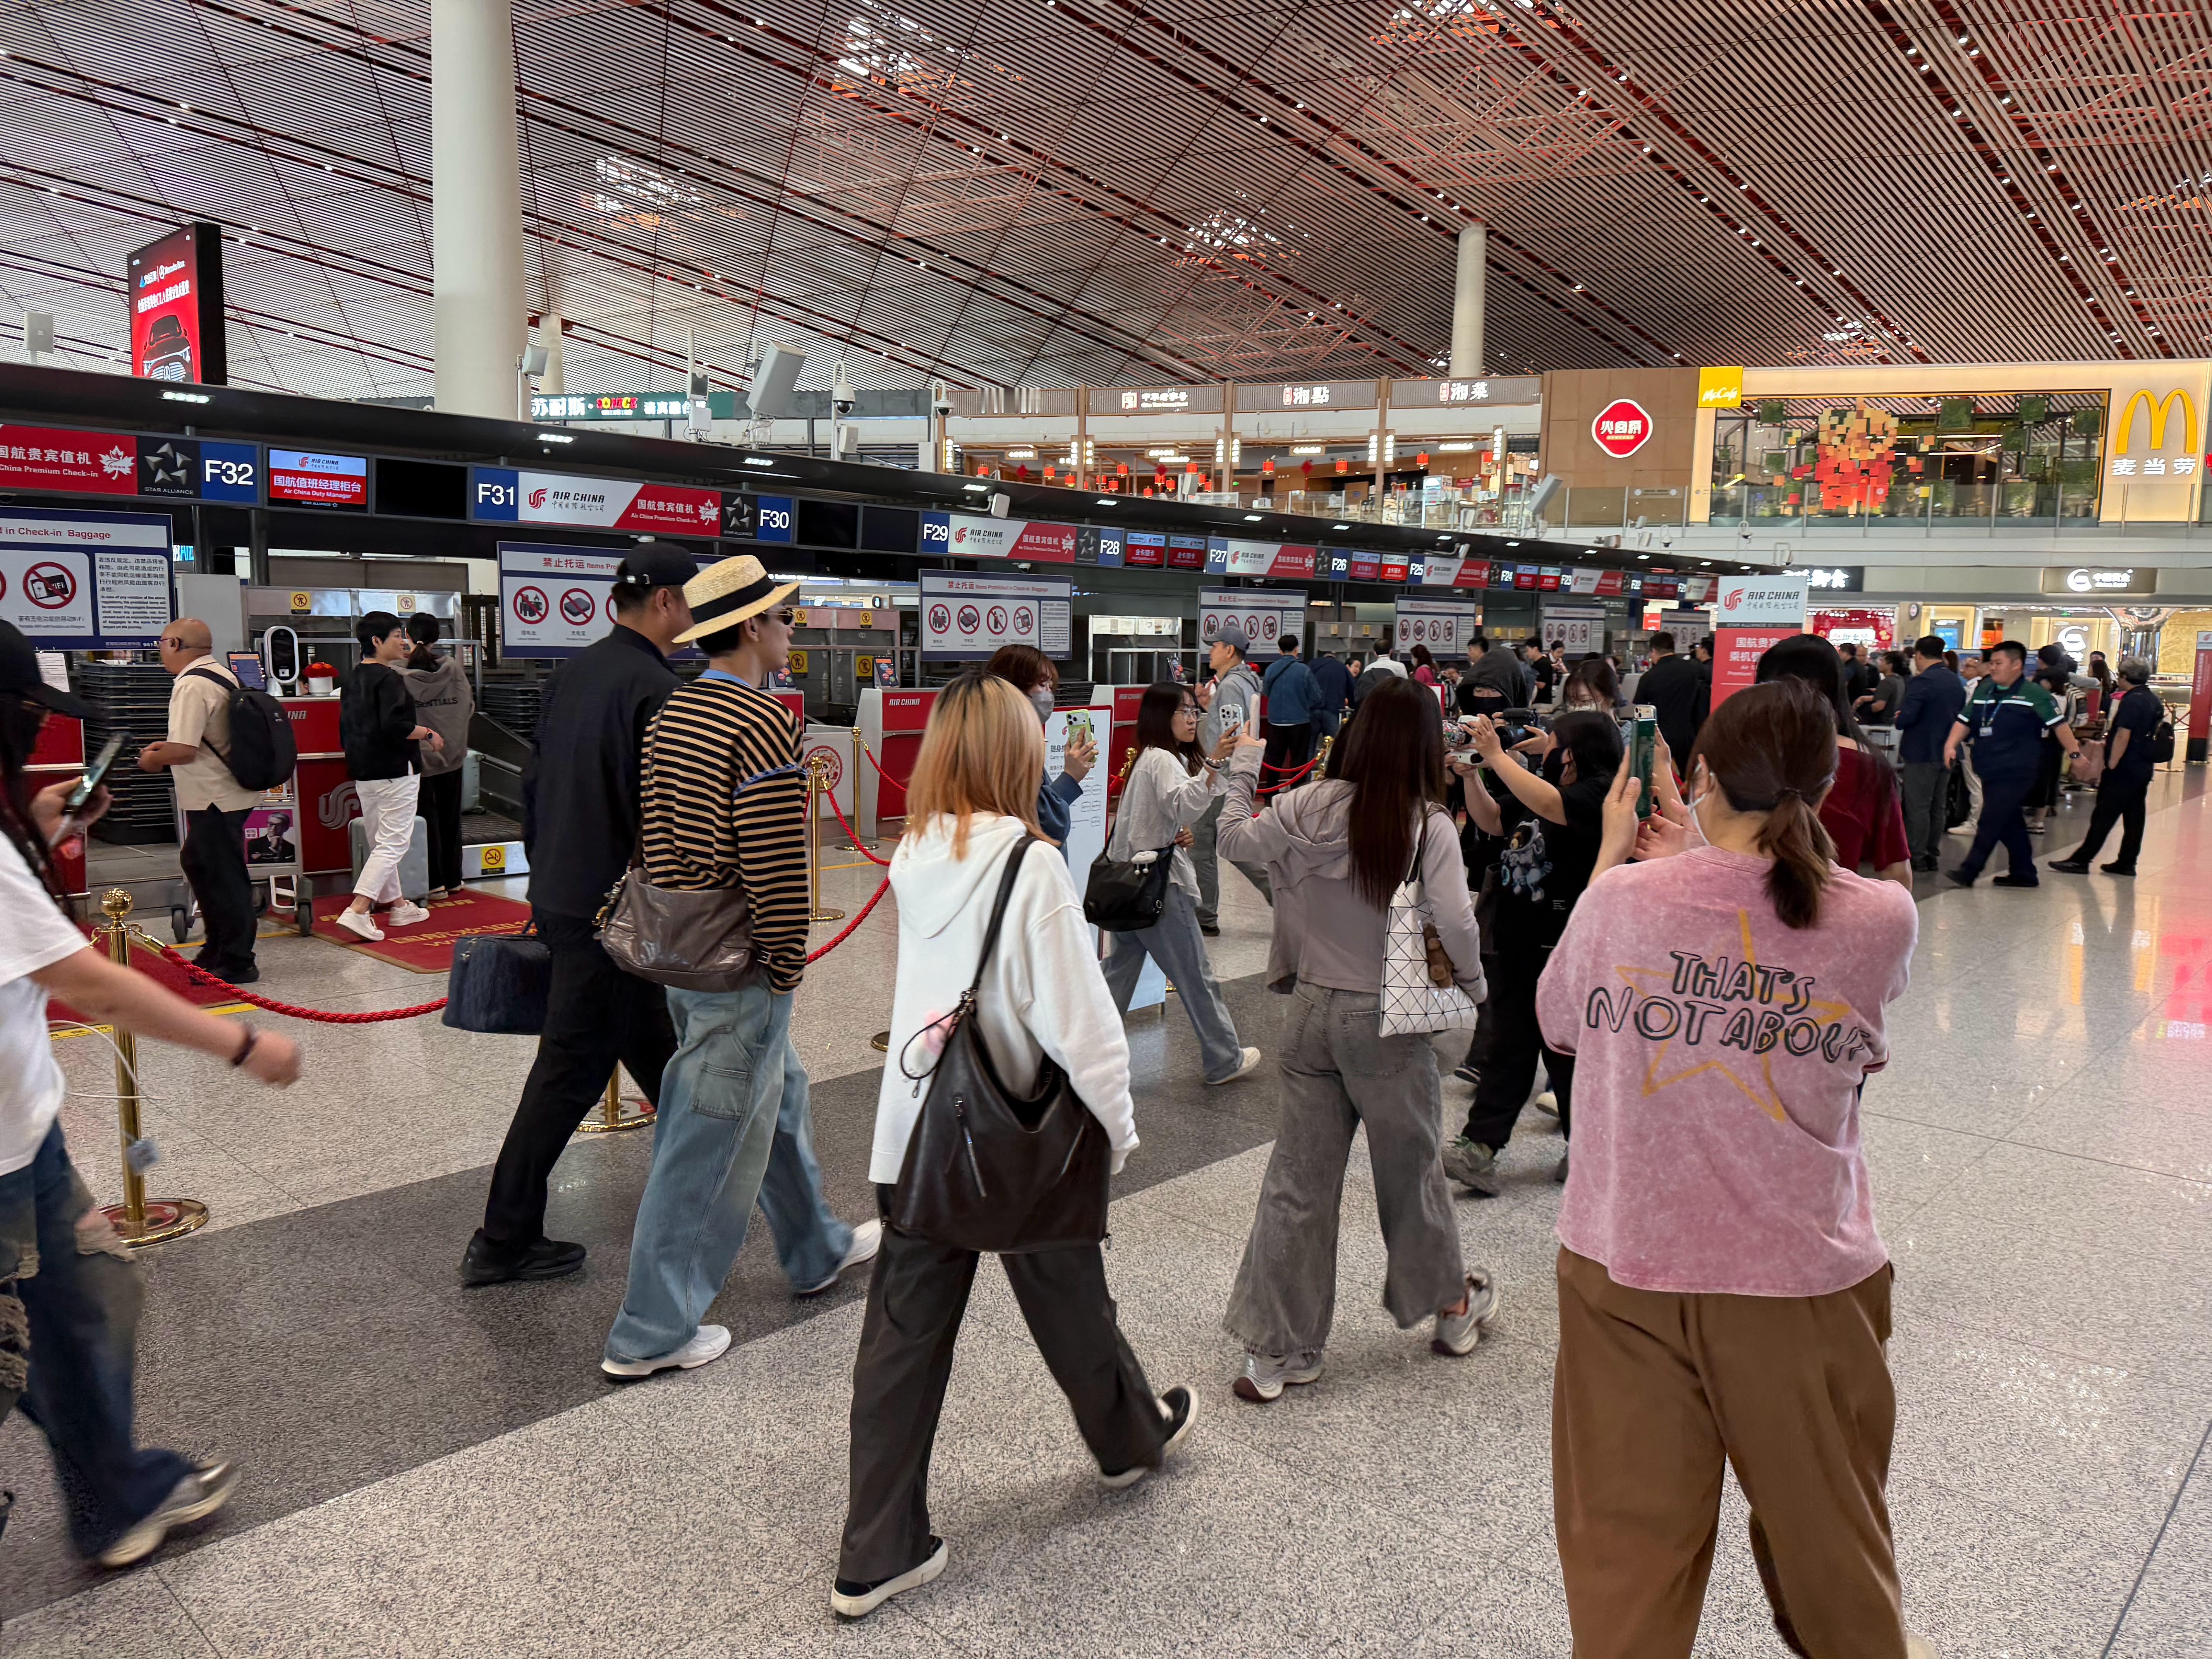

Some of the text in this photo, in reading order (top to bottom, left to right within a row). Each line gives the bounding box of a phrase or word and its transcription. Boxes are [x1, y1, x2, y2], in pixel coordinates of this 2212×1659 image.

[1450, 381, 1489, 400] 湘菜
[0, 445, 92, 465] 国航贵宾值机
[24, 466, 61, 475] Premium
[63, 469, 99, 477] Check-in
[205, 460, 253, 485] F32
[2112, 459, 2196, 476] 麦当劳
[274, 476, 361, 493] 国航值班经理柜台
[478, 483, 514, 505] F31
[553, 491, 605, 503] AIR CHINA
[637, 499, 694, 514] 国航贵宾值机
[760, 509, 789, 529] F30
[18, 528, 62, 536] Check-in
[68, 530, 111, 540] Baggage
[924, 524, 948, 541] F29
[983, 530, 1003, 538] CHINA
[1100, 539, 1120, 555] F28
[543, 557, 585, 569] 禁止托运
[1210, 549, 1227, 563] F27
[1332, 558, 1347, 571] F26
[1410, 563, 1424, 576] F25
[1501, 570, 1513, 582] F24
[1561, 575, 1572, 586] F23
[1747, 591, 1800, 599] AIR CHINA
[288, 711, 307, 720] INA
[1670, 950, 1815, 1015] THAT'S
[1587, 986, 1727, 1046] NOT
